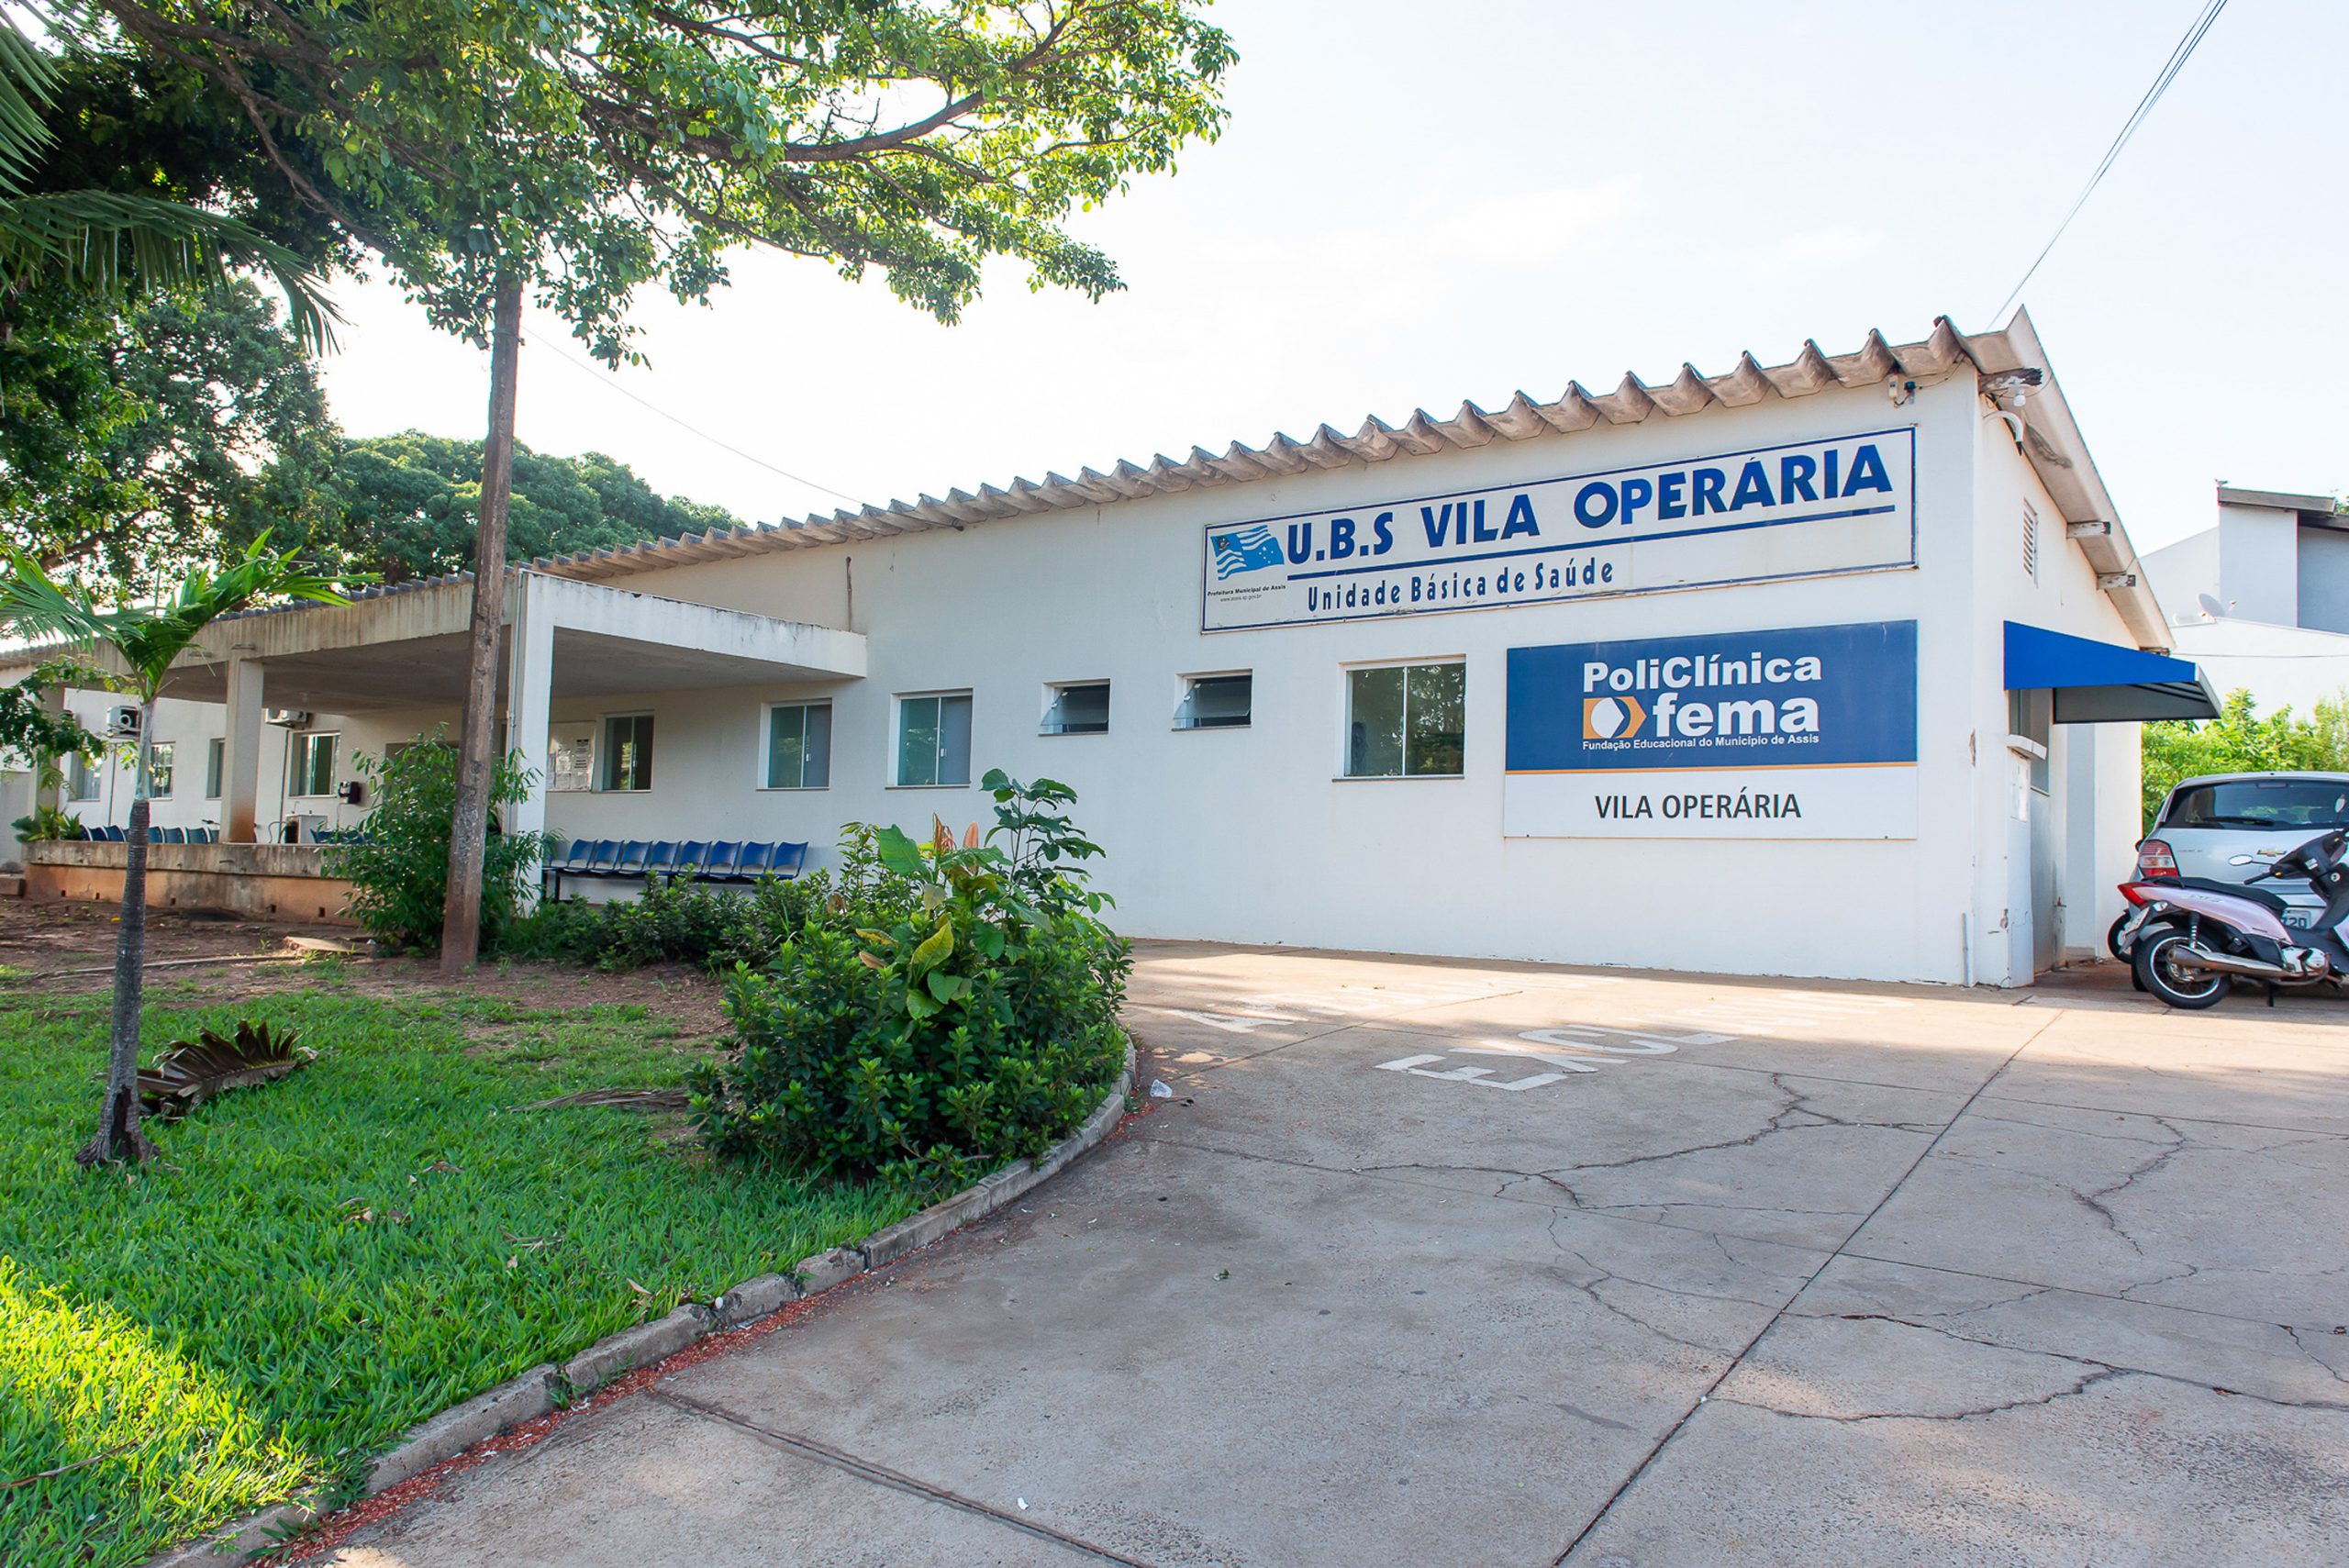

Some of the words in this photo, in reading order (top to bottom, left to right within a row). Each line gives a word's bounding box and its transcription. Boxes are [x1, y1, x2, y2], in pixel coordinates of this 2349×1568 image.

[1286, 511, 1394, 565] U.B.S
[1419, 494, 1541, 549] VILA
[1574, 443, 1895, 529] OPERÁRIA
[1308, 579, 1401, 613] Unidade
[1410, 574, 1487, 603] Básica
[1497, 566, 1525, 594] de
[1535, 556, 1613, 591] Saúde
[1583, 651, 1822, 693] PoliClínica
[1653, 692, 1820, 738] fema
[1583, 740, 1631, 751] Fundação
[1633, 738, 1697, 749] Educacional
[1698, 737, 1713, 747] do
[1715, 735, 1769, 748] Município
[1770, 735, 1786, 745] de
[1787, 733, 1820, 744] Assis
[1595, 795, 1653, 819] VILA
[1662, 786, 1802, 818] OPERÁRIA
